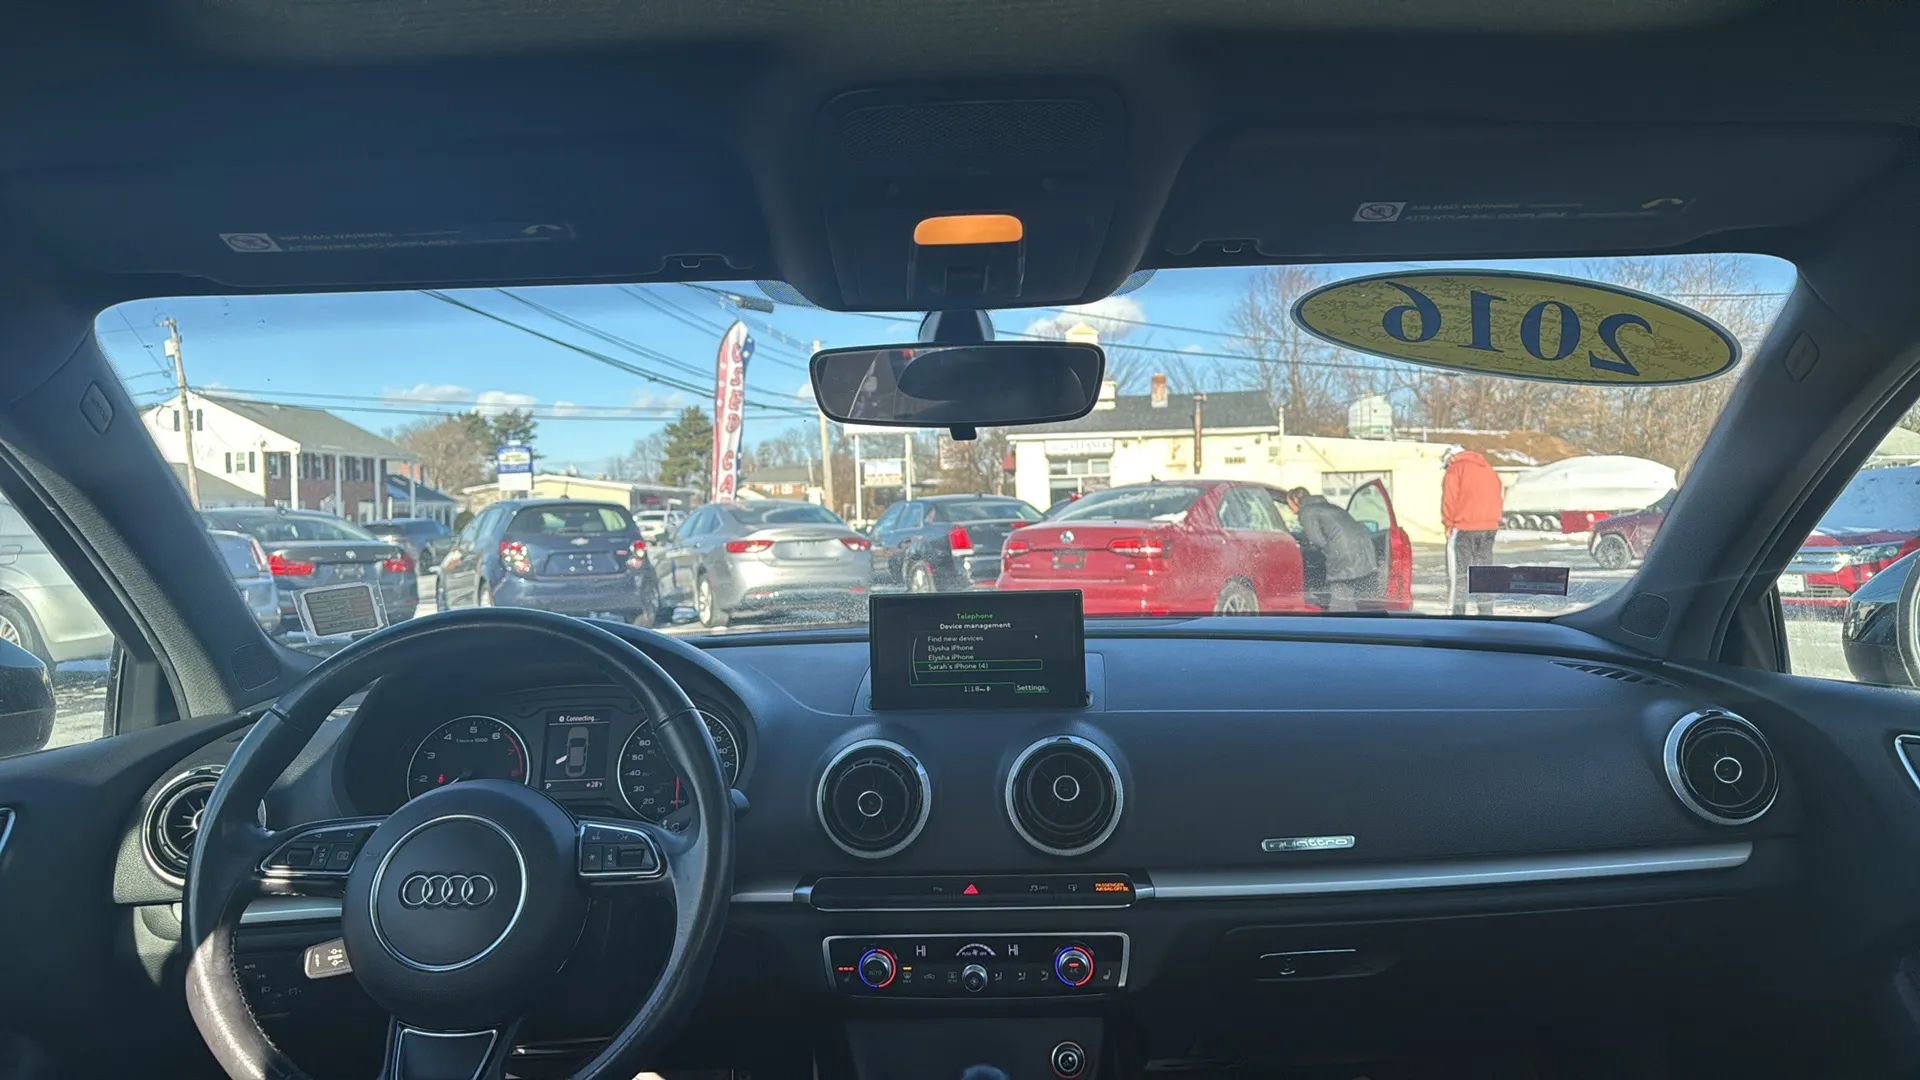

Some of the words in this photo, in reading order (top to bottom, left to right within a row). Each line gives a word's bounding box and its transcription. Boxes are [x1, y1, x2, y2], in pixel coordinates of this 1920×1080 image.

[725, 342, 744, 433] USED
[719, 449, 735, 504] CA
[963, 622, 1011, 630] management
[927, 645, 950, 653] Elysha
[928, 654, 950, 662] Elysha
[928, 663, 953, 671] Sarah's
[1016, 684, 1046, 692] Settings
[469, 726, 478, 734] 5
[491, 732, 501, 740] 6
[427, 752, 436, 760] 3
